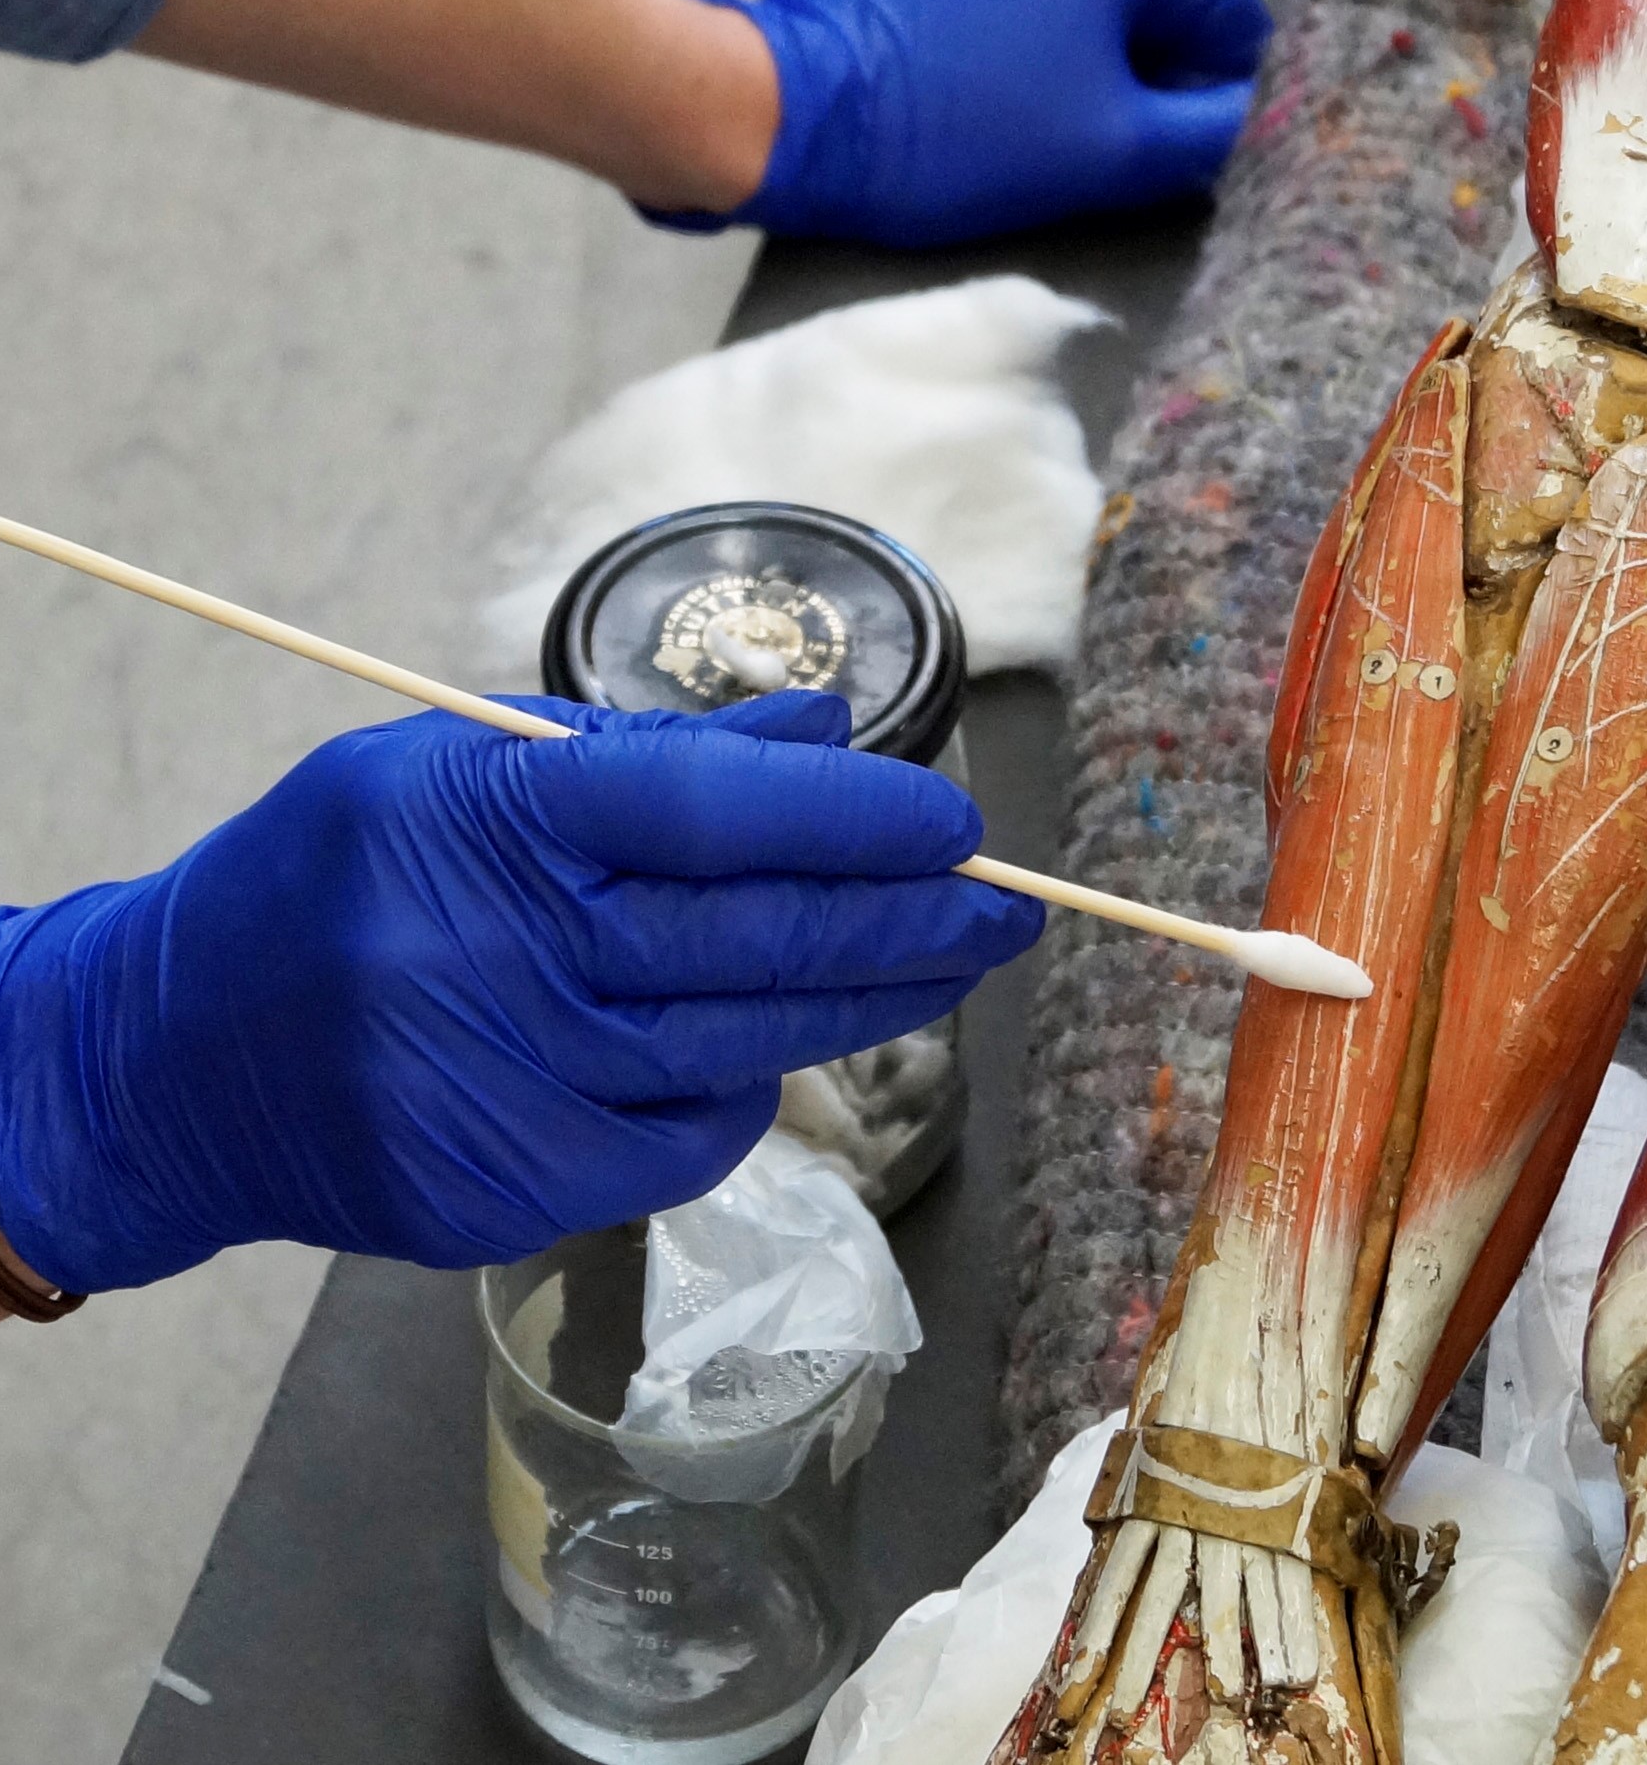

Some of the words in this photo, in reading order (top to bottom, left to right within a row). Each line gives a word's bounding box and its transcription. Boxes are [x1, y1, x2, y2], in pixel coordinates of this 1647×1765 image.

[1369, 659, 1383, 675] 2
[1434, 675, 1443, 691] 1
[1546, 738, 1562, 755] 2
[635, 1545, 673, 1561] 125
[634, 1589, 672, 1605] 100
